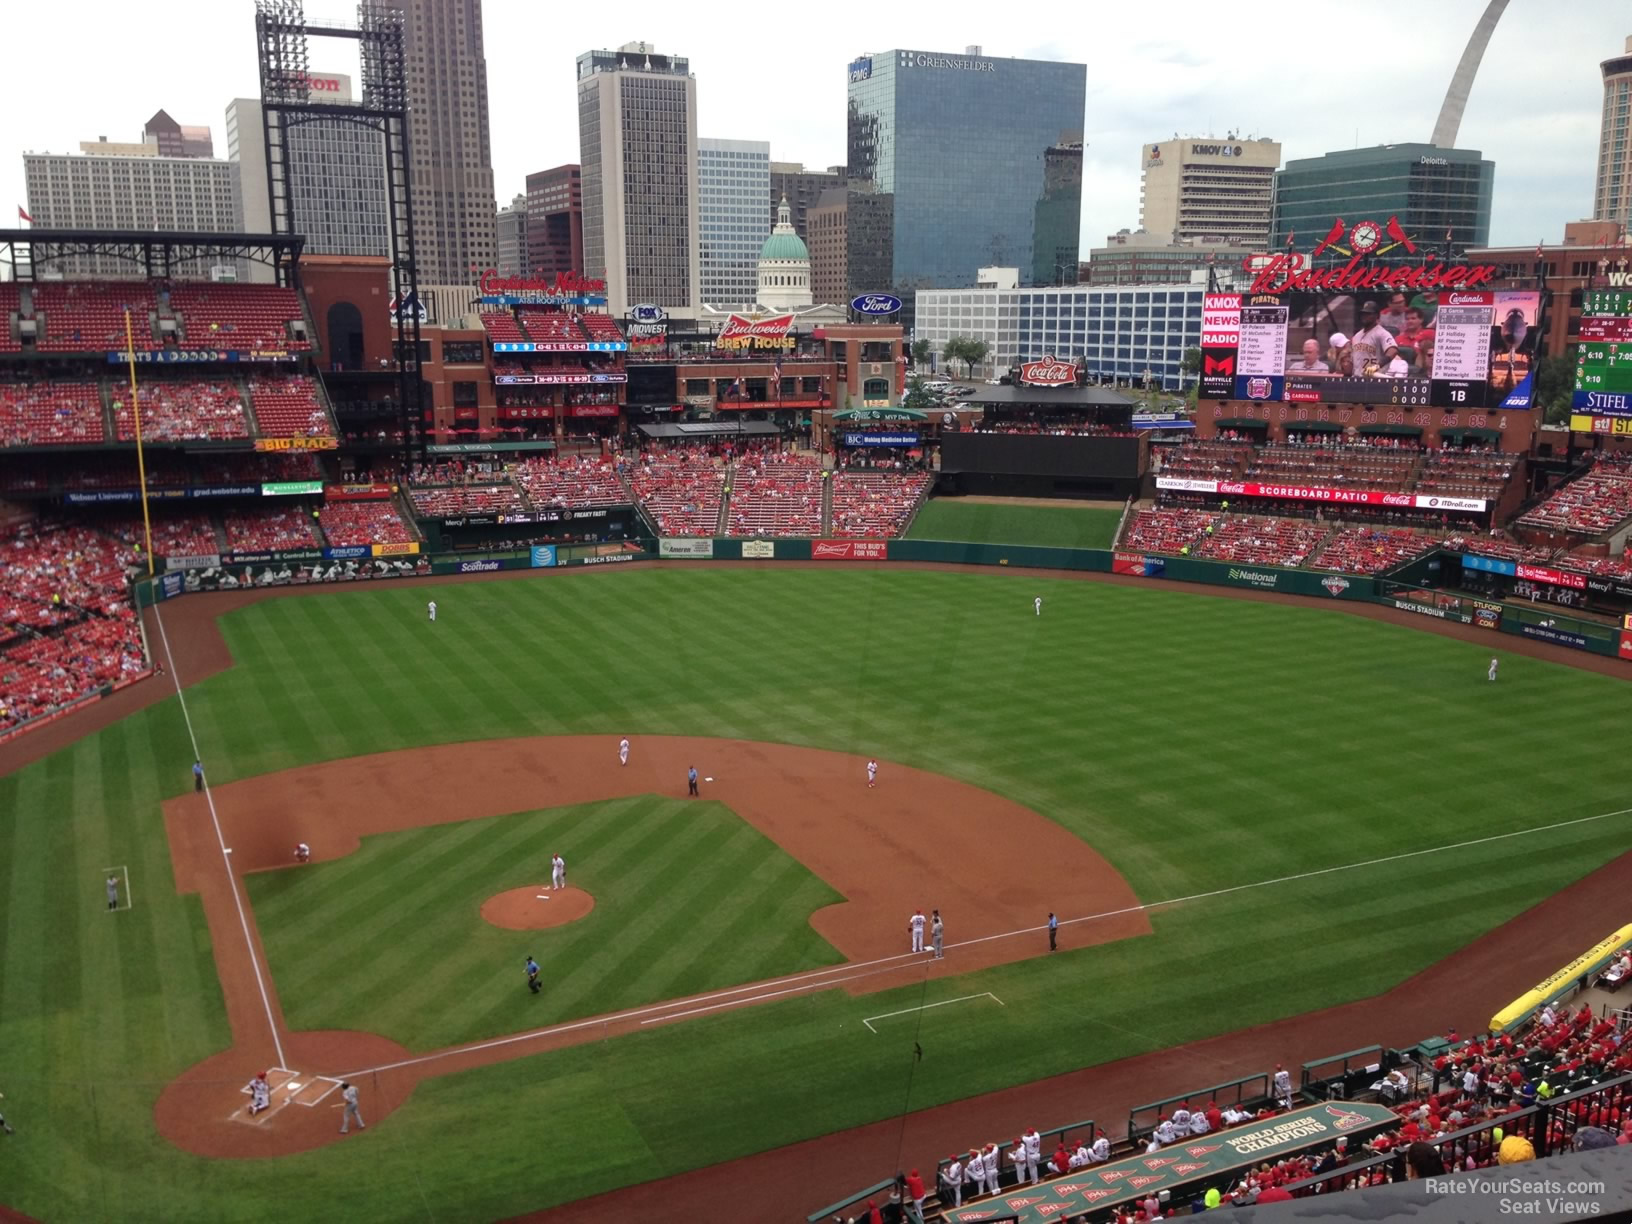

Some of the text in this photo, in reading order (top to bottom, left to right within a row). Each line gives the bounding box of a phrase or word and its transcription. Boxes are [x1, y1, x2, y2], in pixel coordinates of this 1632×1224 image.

[1192, 144, 1221, 156] KMOV
[1242, 252, 1497, 294] Budweiser
[480, 270, 605, 295] Cardinals Nation
[862, 296, 892, 310] Ford
[1205, 297, 1240, 309] KMOX
[1250, 296, 1280, 305] PIRATES
[1449, 292, 1484, 304] Cardinals
[638, 308, 656, 316] FOX
[1204, 316, 1239, 326] NEWS
[627, 324, 668, 337] MIDWEST
[721, 320, 794, 336] Budweiser
[716, 338, 796, 349] BREW HOUSE
[1203, 334, 1238, 343] RADIO
[157, 352, 164, 361] A
[1027, 364, 1068, 380] Coca-Cola
[1450, 391, 1466, 402] 1B
[1587, 392, 1628, 409] STIFEL
[1233, 407, 1487, 428] 1 2 6 9 10 14 17 20 24 42 45 85
[264, 438, 329, 449] BIG MAC
[848, 436, 860, 444] BJC
[98, 492, 133, 500] University
[1220, 484, 1411, 505] Coca-Cola SCOREBOARD PATIO Coca-Cola
[584, 554, 633, 564] BUSCH STADIUM
[1138, 556, 1164, 565] America
[461, 561, 499, 572] Scottrade
[1239, 570, 1277, 582] National
[1535, 574, 1557, 582] Wainwright
[1588, 581, 1608, 592] Mercy
[1396, 600, 1445, 617] BUSCH STADIUM
[1474, 601, 1502, 612] STLFORD
[1478, 619, 1494, 627] .COM
[1226, 1126, 1274, 1147] WORLD
[1275, 1116, 1316, 1138] SERIES
[1236, 1122, 1328, 1154] CHAMPIONS
[1104, 1172, 1122, 1180] 1964
[1132, 1176, 1149, 1184] 1967
[1058, 1185, 1078, 1194] 1944
[1087, 1190, 1107, 1198] 1946
[1011, 1198, 1029, 1207] 1934
[1040, 1204, 1058, 1213] 1942
[963, 1213, 982, 1221] 1926
